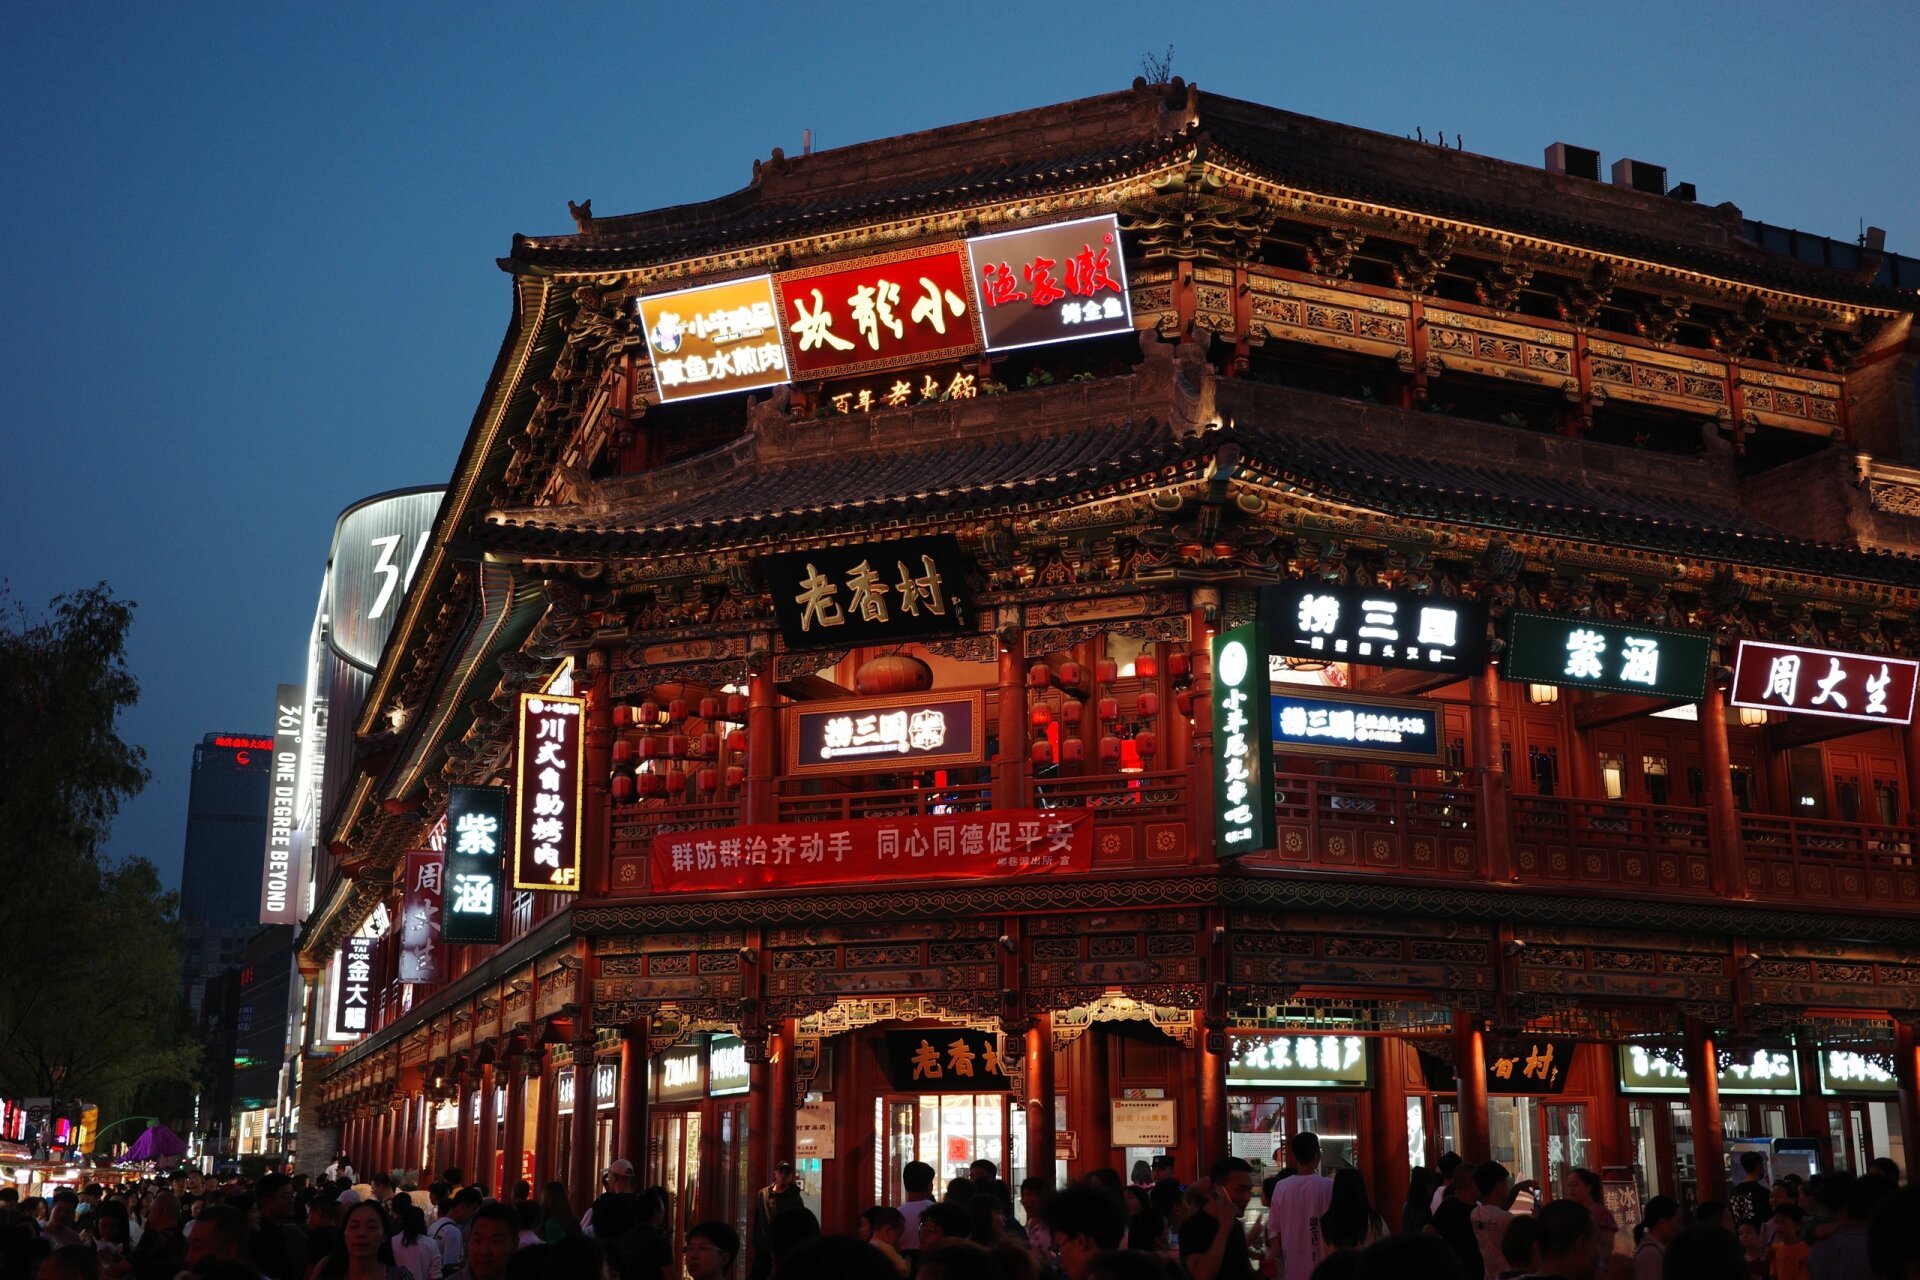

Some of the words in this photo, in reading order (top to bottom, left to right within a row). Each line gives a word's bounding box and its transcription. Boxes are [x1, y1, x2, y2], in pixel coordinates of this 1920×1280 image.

[795, 554, 945, 632] 老香村
[1564, 628, 1659, 685] 紫涵
[1762, 653, 1891, 715] 周大生
[276, 752, 297, 782] ONE
[272, 786, 293, 846] DEGREE
[453, 813, 498, 915] 紫涵
[671, 830, 853, 872] 群防群治齐动手
[877, 820, 1074, 859] 同心同德促平安
[266, 850, 289, 912] BEYOND
[550, 867, 575, 885] 4F
[350, 938, 370, 946] KING
[410, 862, 443, 971] 周大生
[353, 945, 367, 953] TAI
[1229, 1034, 1362, 1070] 北京糖葫芦
